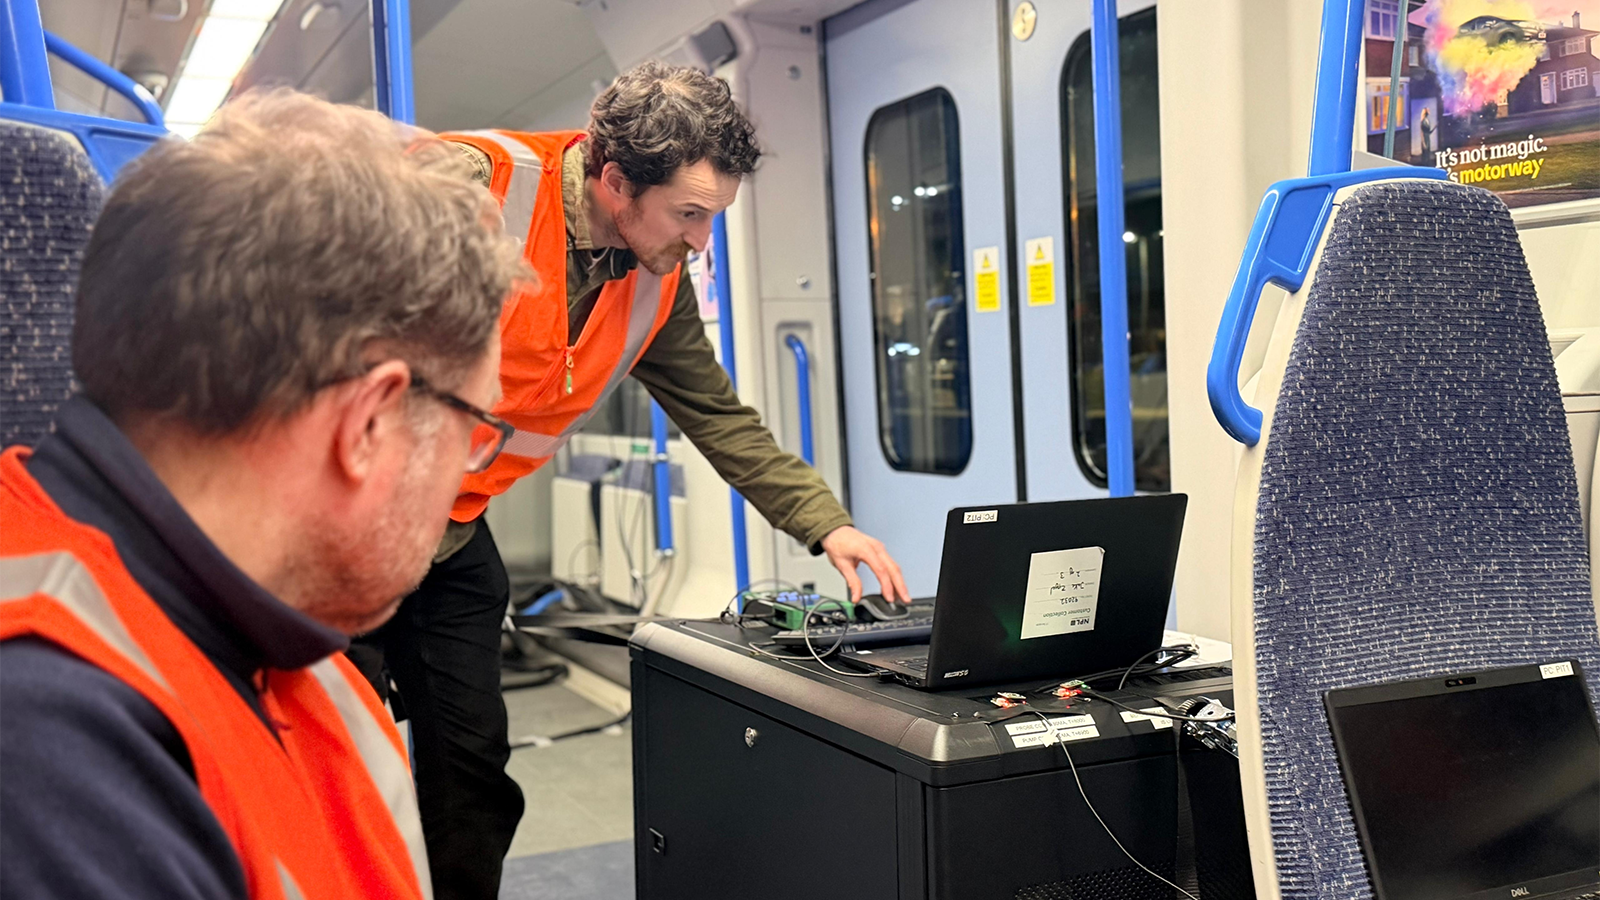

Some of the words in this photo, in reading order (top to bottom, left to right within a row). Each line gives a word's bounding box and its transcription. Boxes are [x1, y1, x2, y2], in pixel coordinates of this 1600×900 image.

[1435, 147, 1458, 168] It's
[1459, 144, 1488, 165] not
[1489, 134, 1548, 160] magic.
[1460, 158, 1545, 184] motorway
[1060, 571, 1065, 579] 3
[1043, 610, 1067, 618] Collection
[1077, 618, 1090, 626] NPL
[1555, 664, 1570, 674] PIT1
[1511, 886, 1530, 897] DELL
